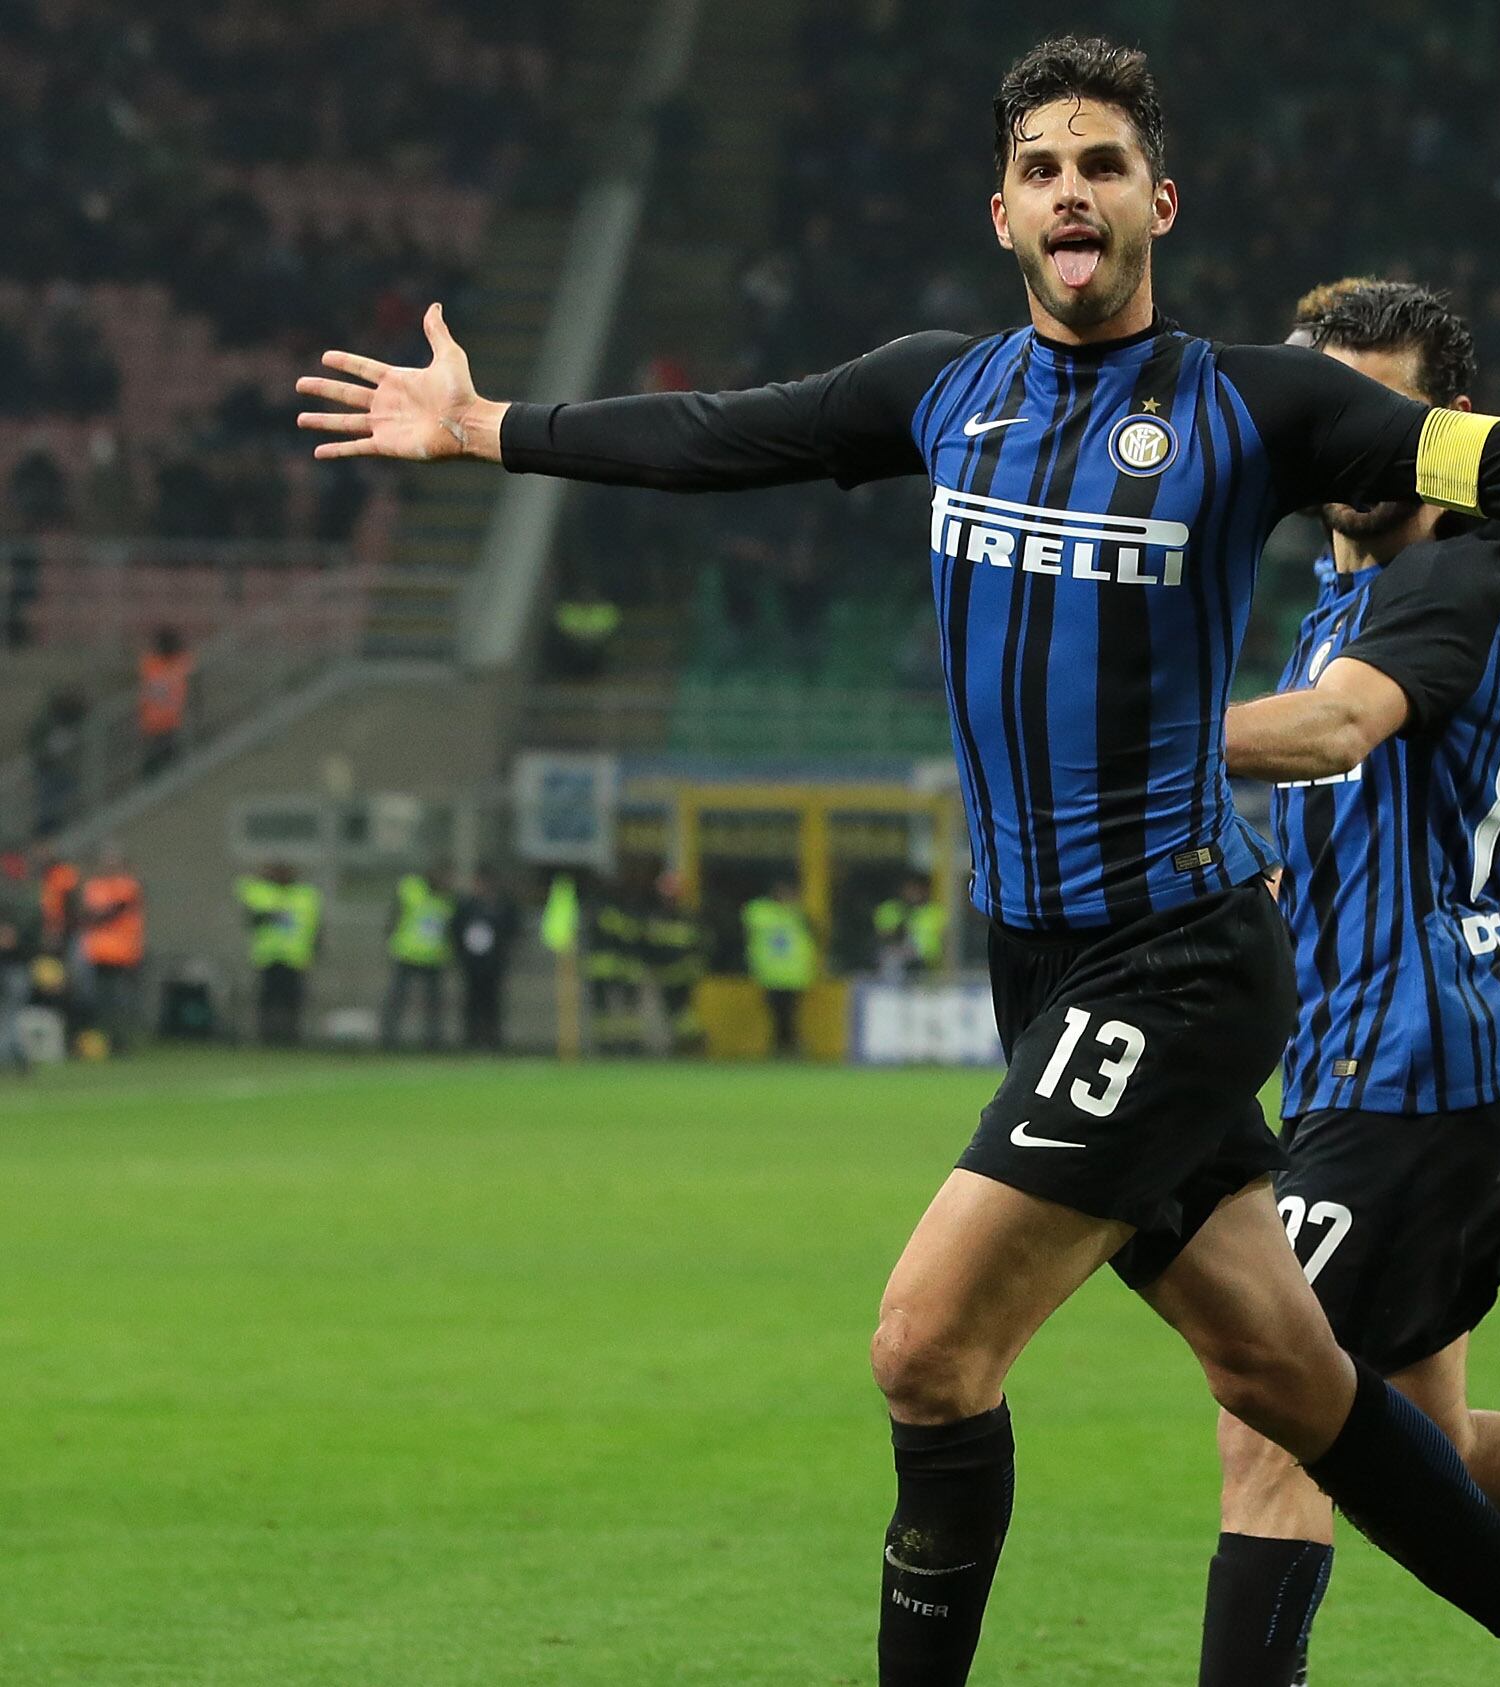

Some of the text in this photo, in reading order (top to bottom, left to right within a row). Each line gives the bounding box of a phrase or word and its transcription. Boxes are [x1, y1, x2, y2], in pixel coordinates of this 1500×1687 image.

[931, 485, 1189, 586] PIRELLI
[1034, 1006, 1146, 1117] 13
[892, 1588, 949, 1618] INTER
